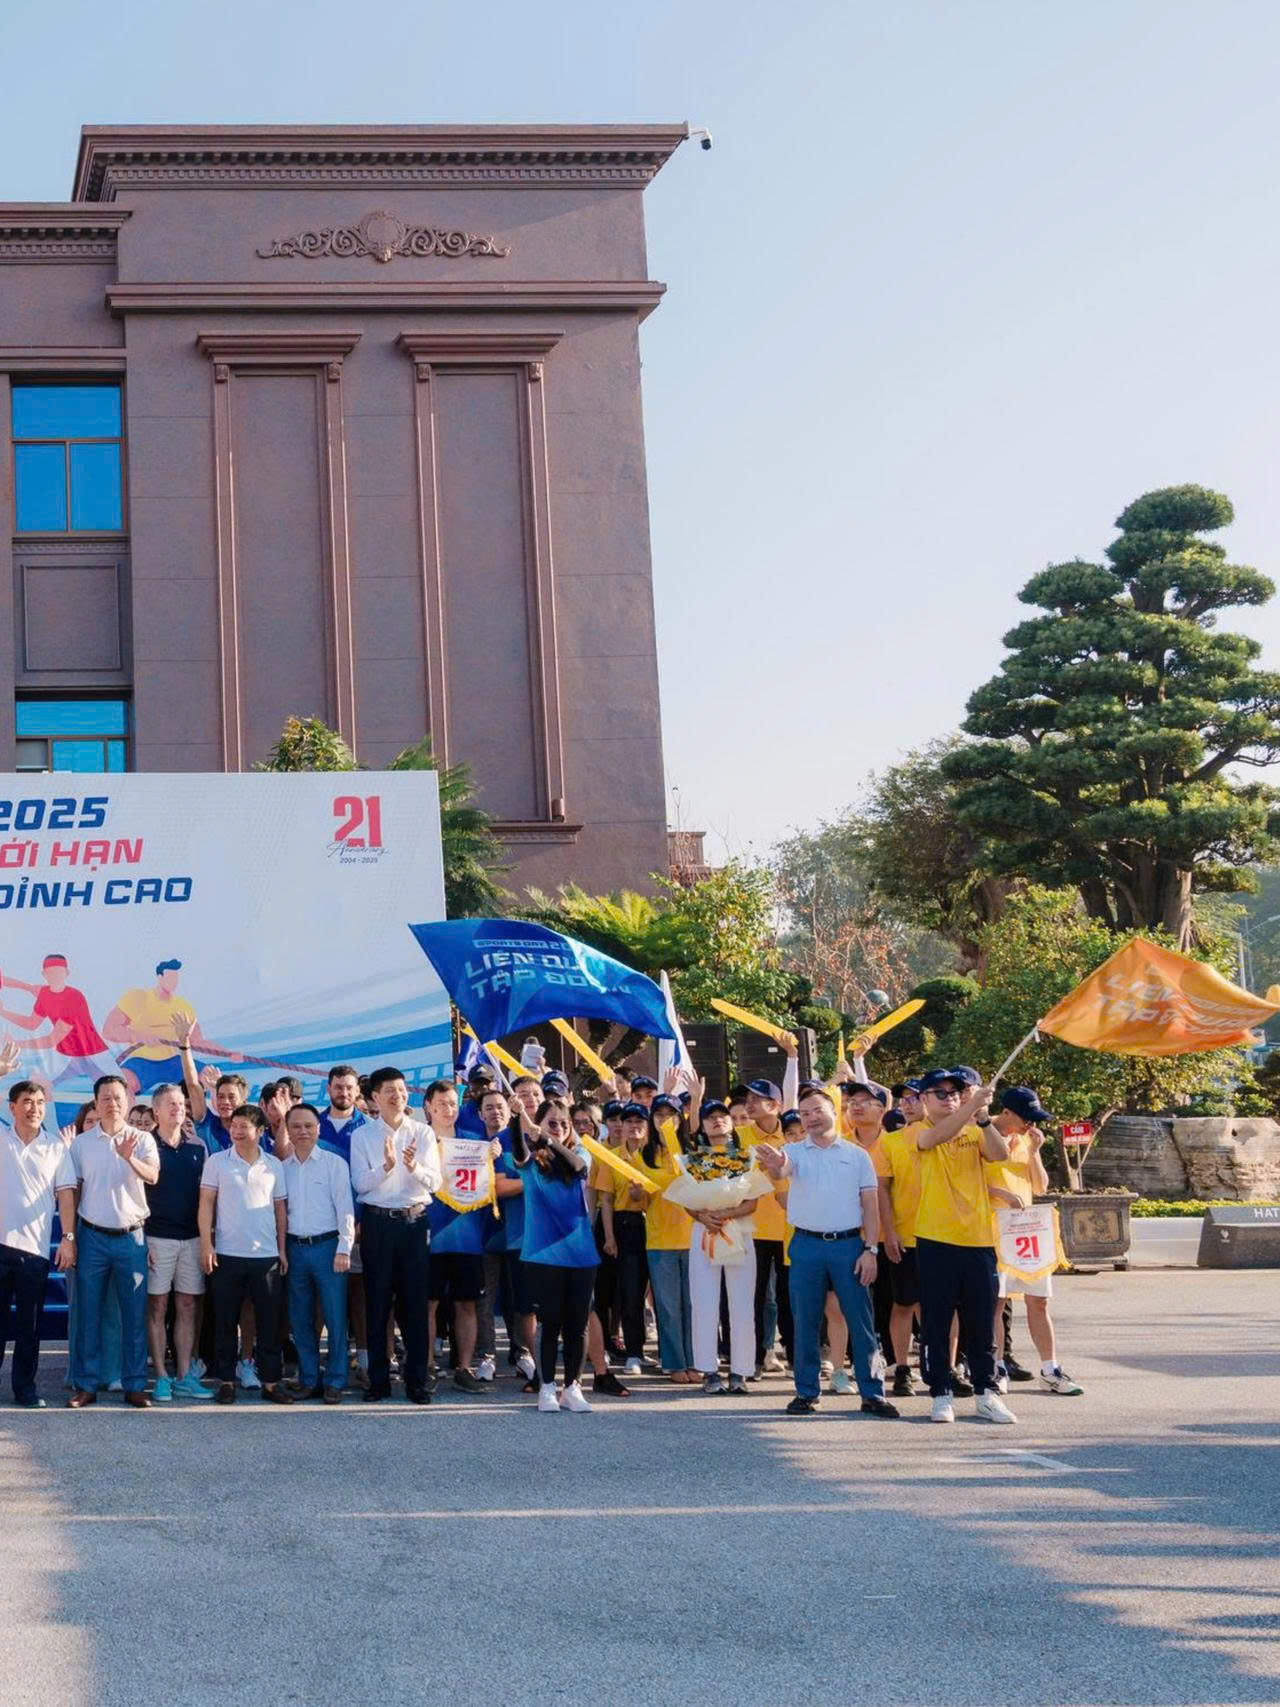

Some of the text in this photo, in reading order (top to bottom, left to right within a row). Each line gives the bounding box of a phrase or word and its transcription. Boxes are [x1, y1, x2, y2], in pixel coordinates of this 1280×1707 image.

[333, 795, 383, 848] 21
[49, 838, 144, 872] HẠN
[103, 877, 193, 905] CAO
[464, 950, 535, 979] LIÊN
[471, 969, 537, 999] TẬP
[455, 1168, 477, 1192] 21
[1254, 1207, 1280, 1218] HAT
[1015, 1235, 1040, 1258] 21
